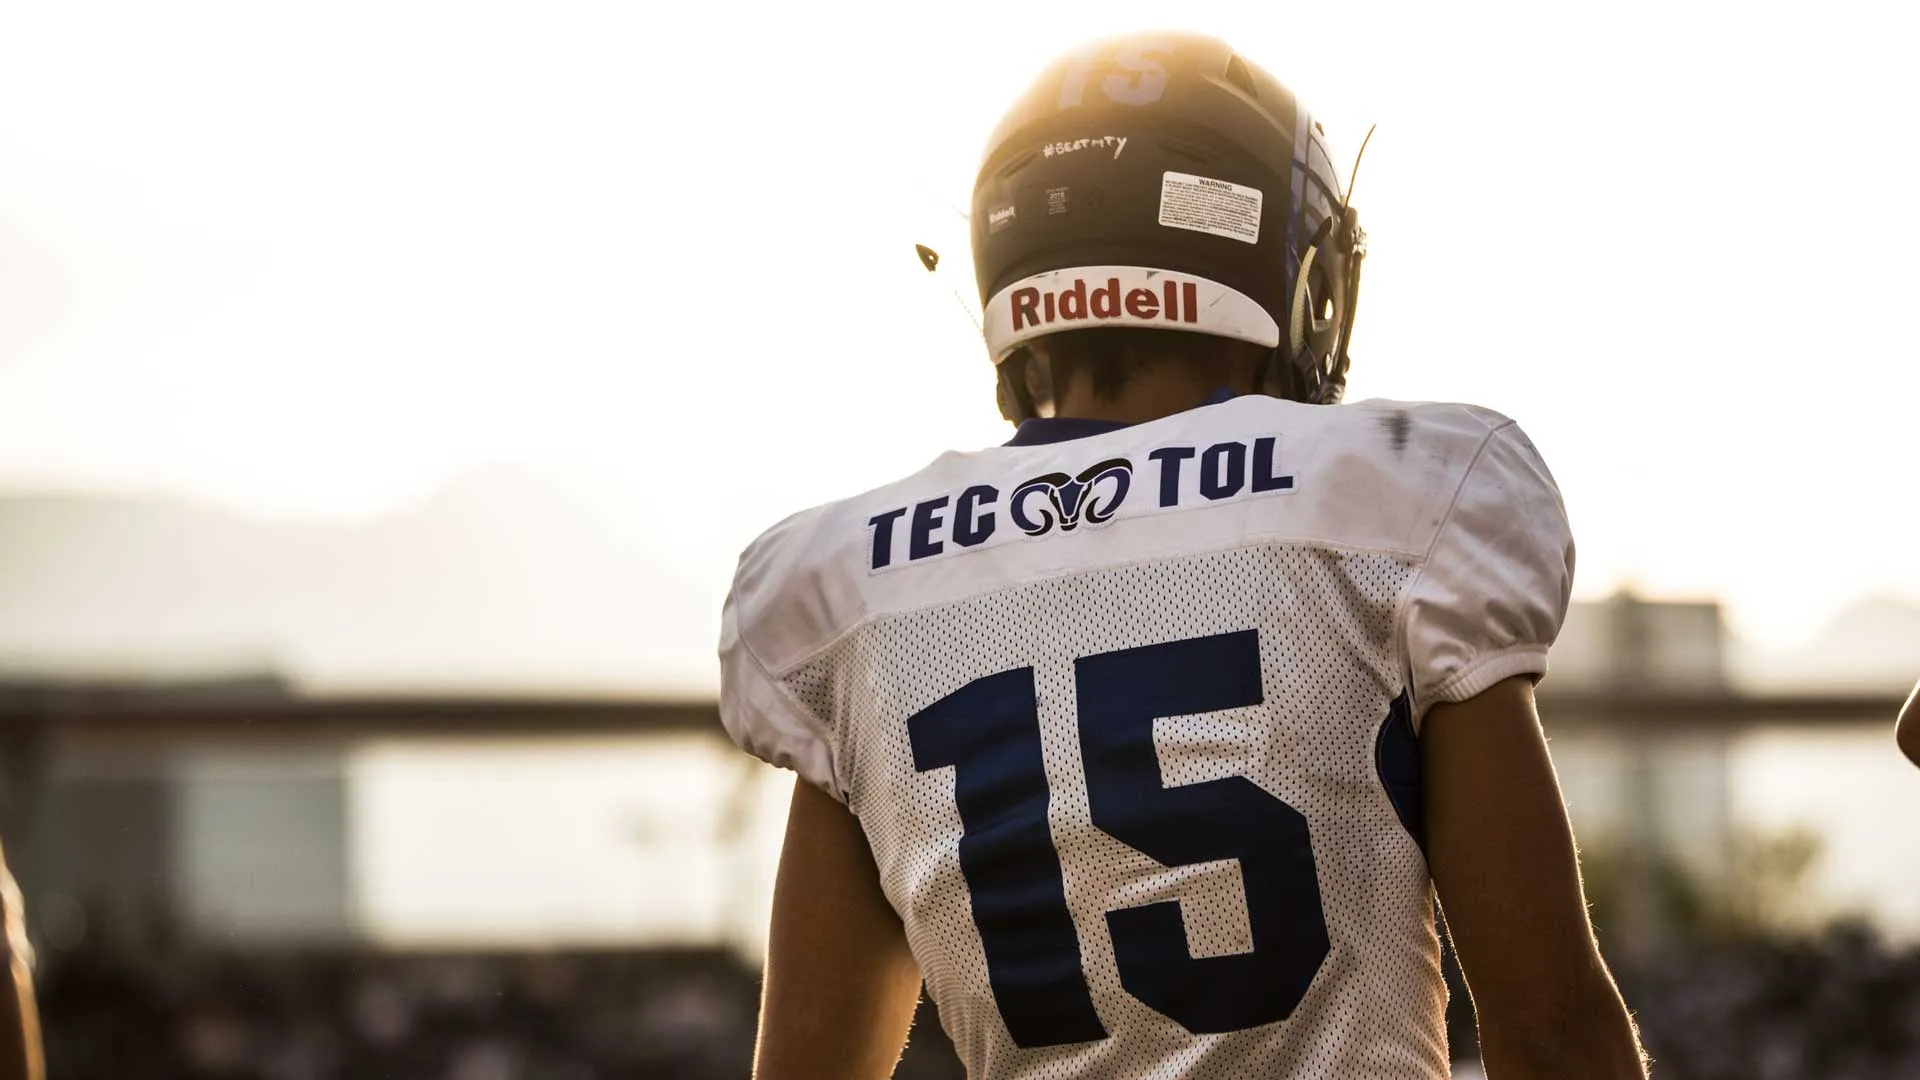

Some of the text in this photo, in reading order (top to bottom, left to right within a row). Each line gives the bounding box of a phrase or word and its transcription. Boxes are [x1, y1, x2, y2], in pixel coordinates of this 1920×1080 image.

[1058, 38, 1175, 109] 15
[1199, 178, 1233, 191] WARNING
[1011, 278, 1198, 332] Riddell
[868, 437, 1294, 570] TEC TOL
[906, 629, 1331, 1049] 15
